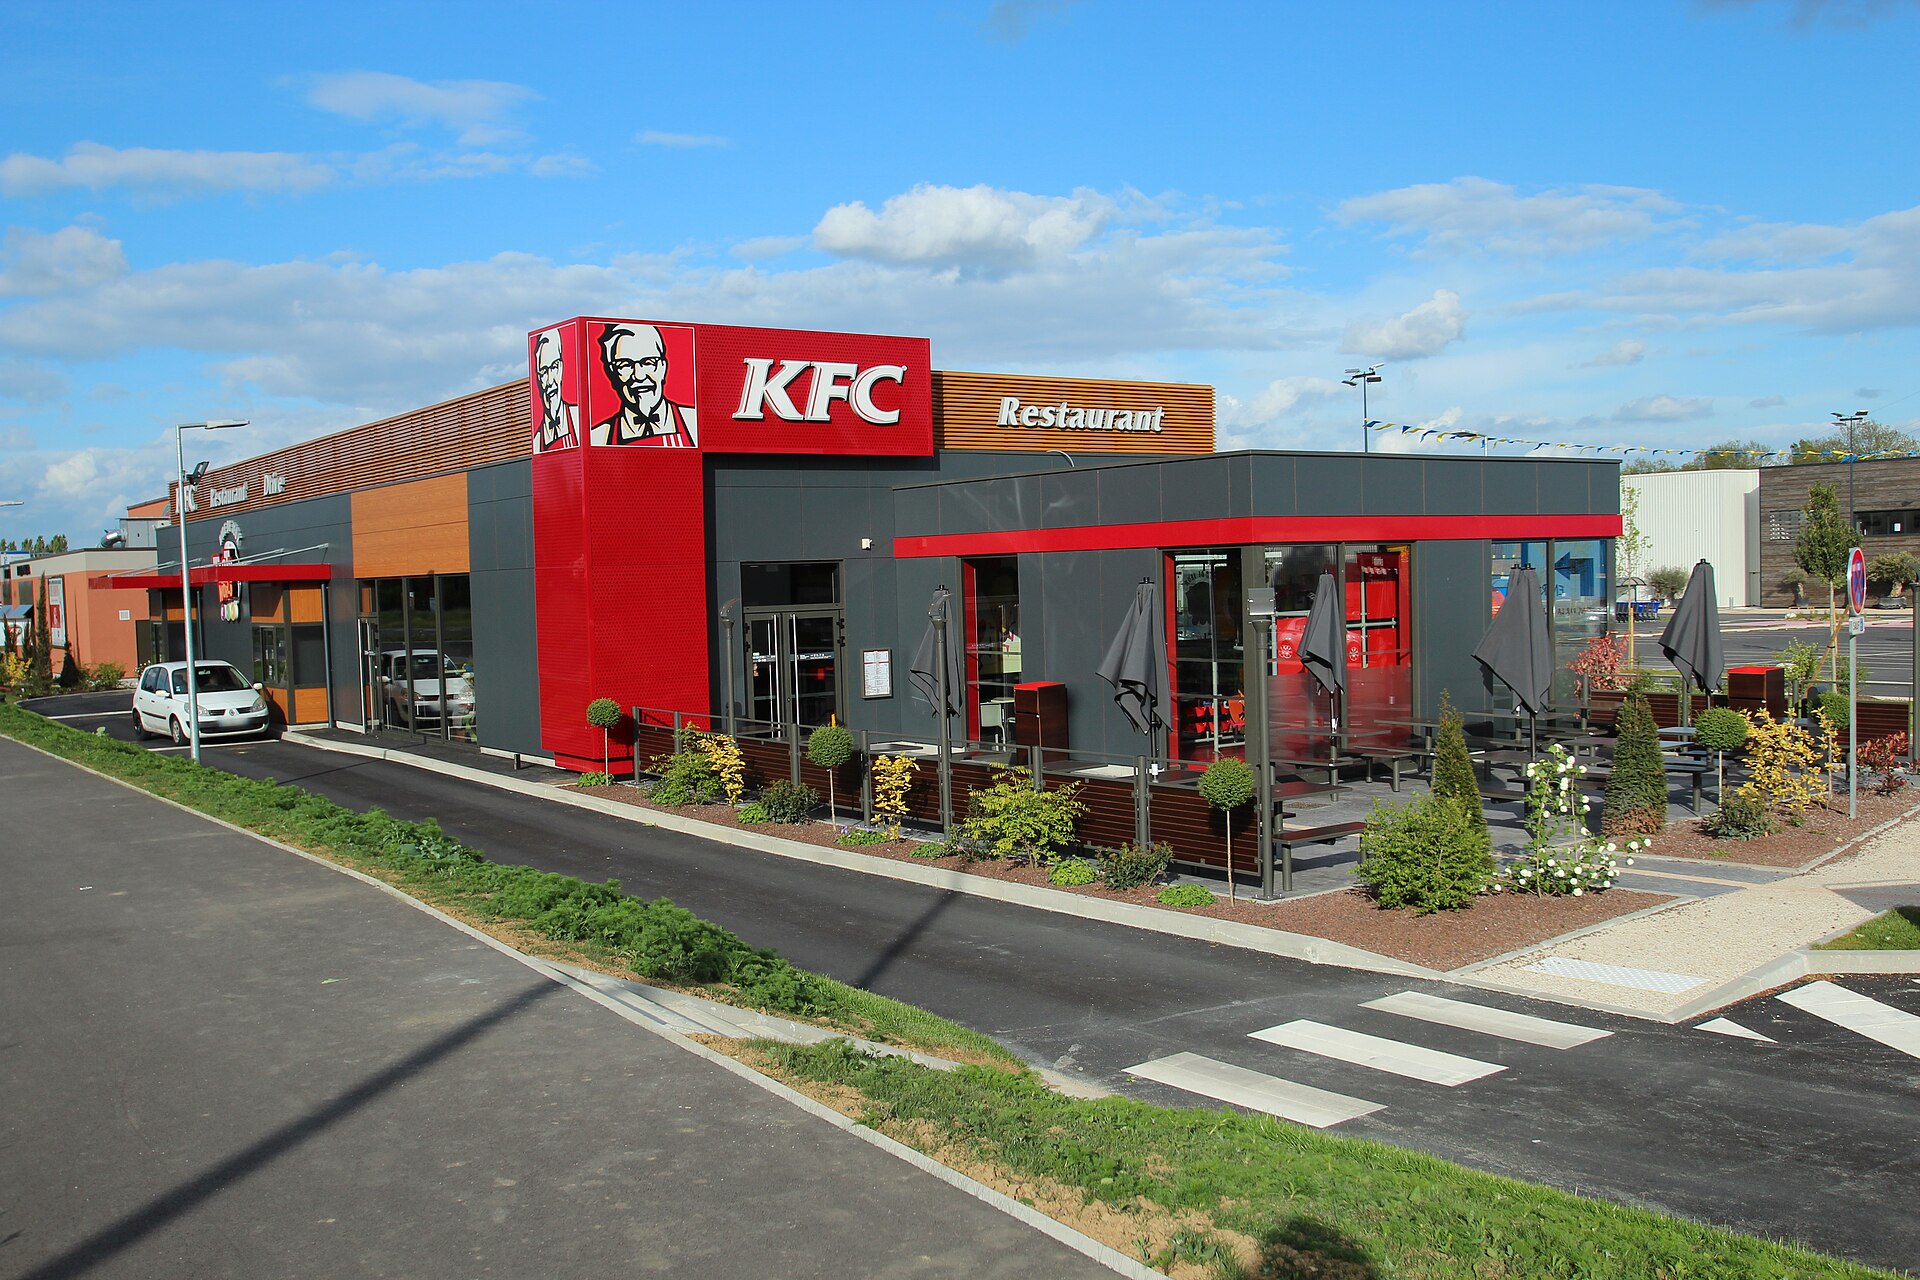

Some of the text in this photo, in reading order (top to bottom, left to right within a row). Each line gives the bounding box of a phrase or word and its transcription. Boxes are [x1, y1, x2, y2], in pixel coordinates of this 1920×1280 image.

[731, 357, 905, 426] KFC
[996, 396, 1165, 432] Restaurant
[210, 481, 248, 508] Restaurant
[263, 472, 285, 496] Drive
